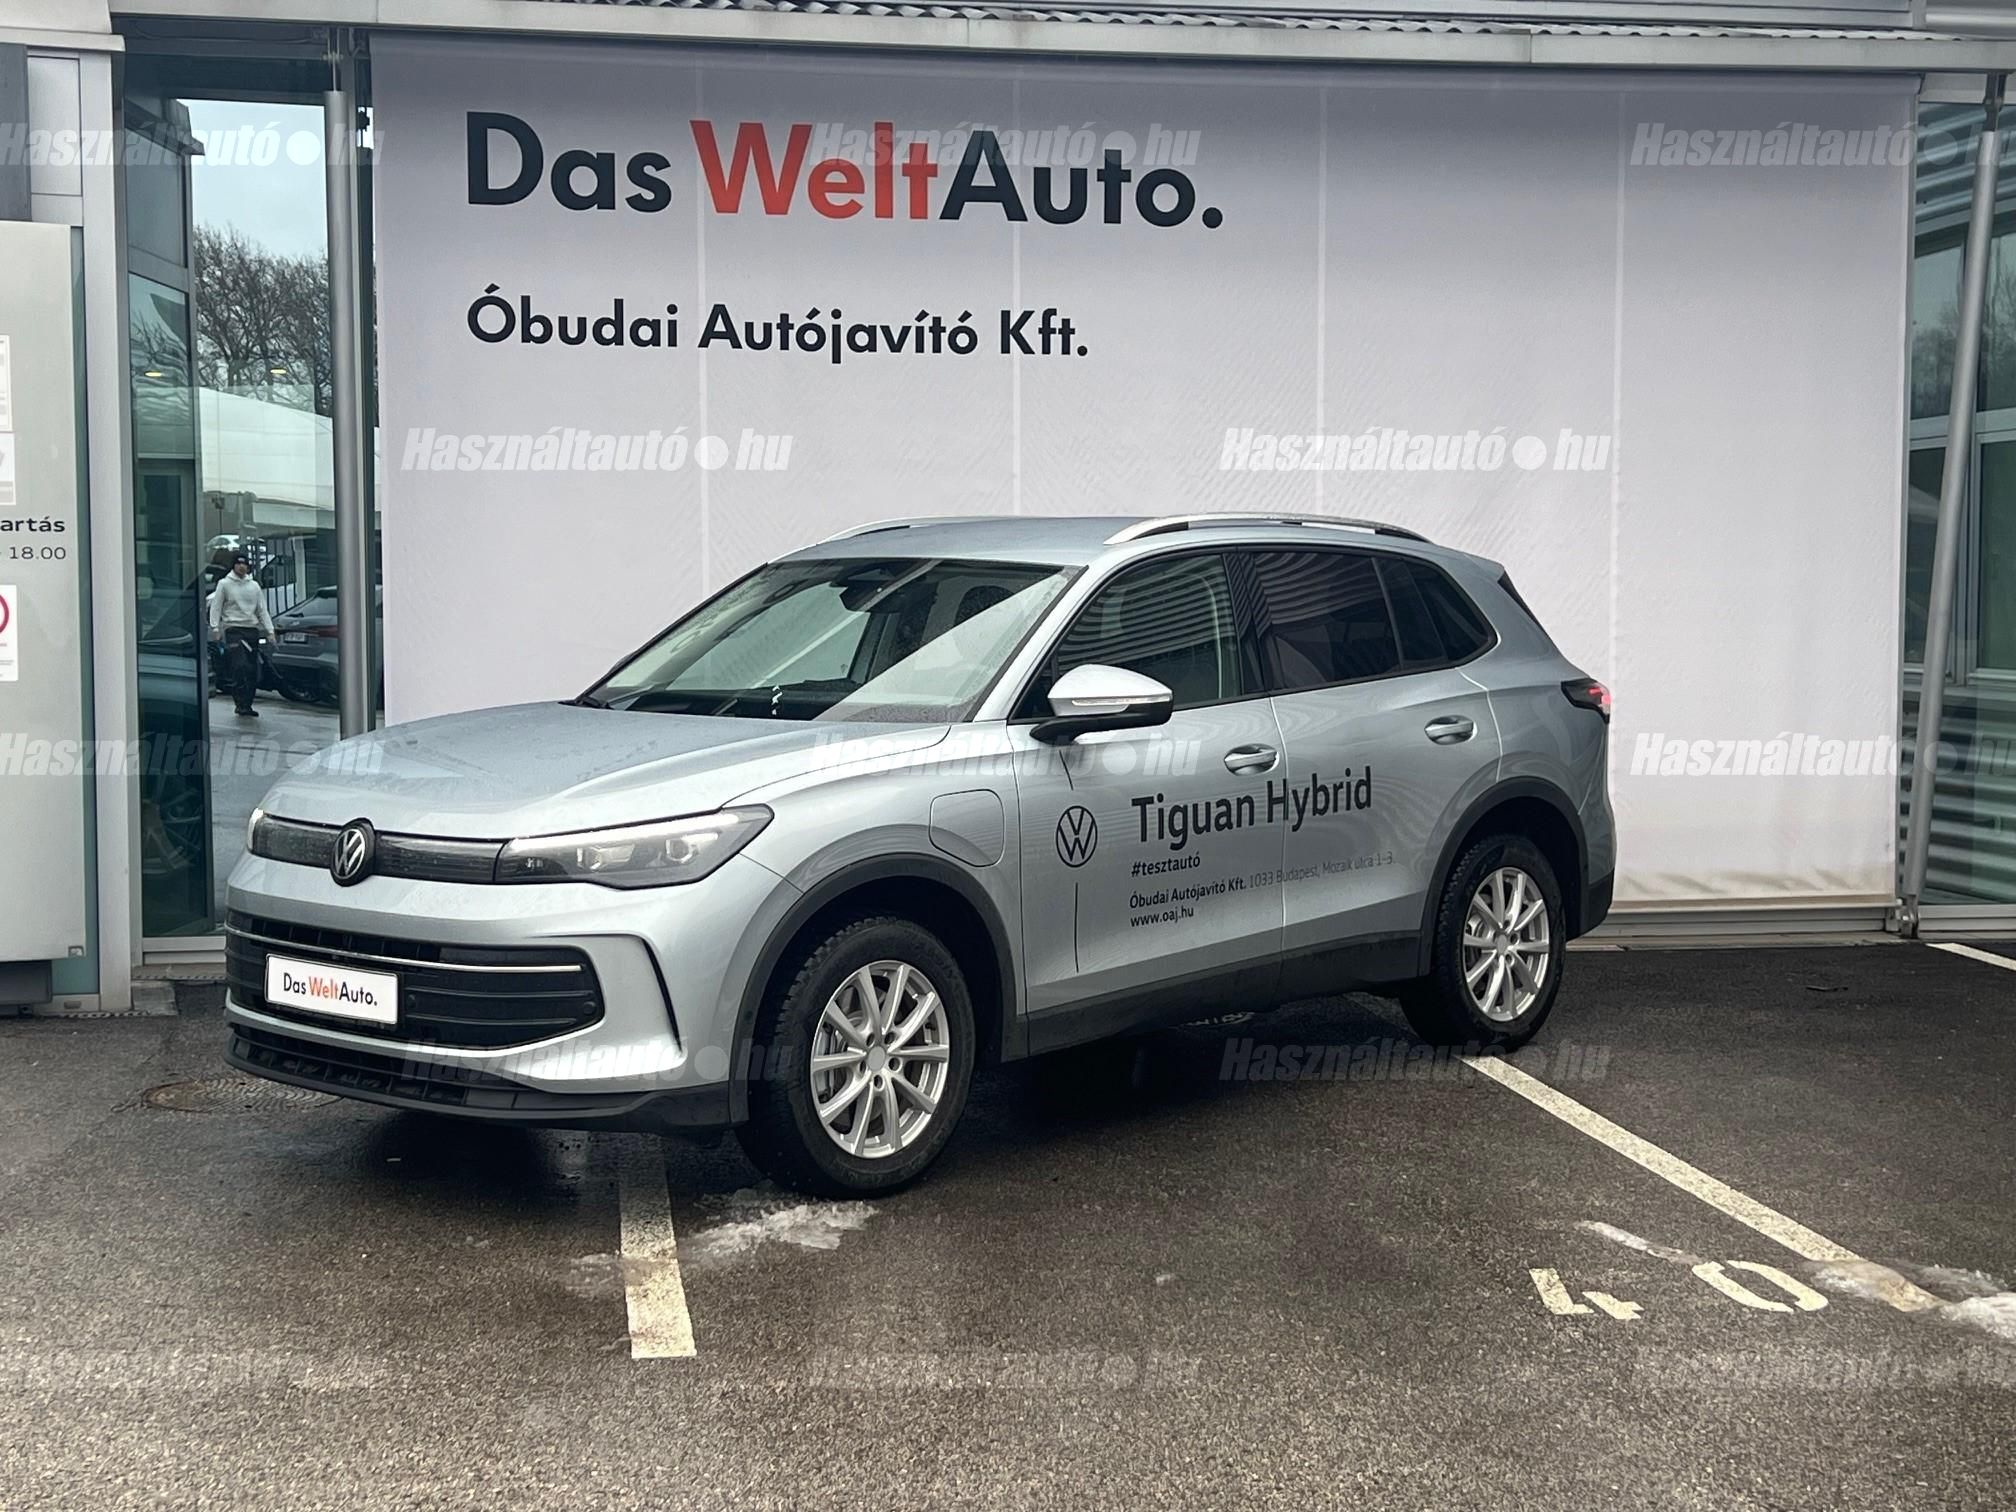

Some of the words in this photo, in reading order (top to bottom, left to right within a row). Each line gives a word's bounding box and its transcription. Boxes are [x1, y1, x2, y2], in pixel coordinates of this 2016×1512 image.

[465, 111, 672, 213] Das
[690, 120, 1224, 229] WeltAuto.
[467, 283, 679, 347] Óbudai
[698, 303, 979, 364] Autójavító
[1000, 308, 1089, 357] Kft.
[9, 546, 66, 560] 18.00
[1131, 793, 1255, 850] Tiguan
[1267, 766, 1372, 832] Hybrid
[1131, 851, 1201, 877] #tesztautó
[1129, 889, 1169, 909] Óbudai
[1171, 879, 1226, 901] Autójavító
[1228, 876, 1247, 891] Kft.
[1249, 870, 1274, 888] 1033
[1130, 905, 1194, 927] www.oaj.hu
[283, 972, 307, 995] Das
[308, 976, 378, 1006] WeltAuto.
[1529, 1260, 1829, 1320] 40
